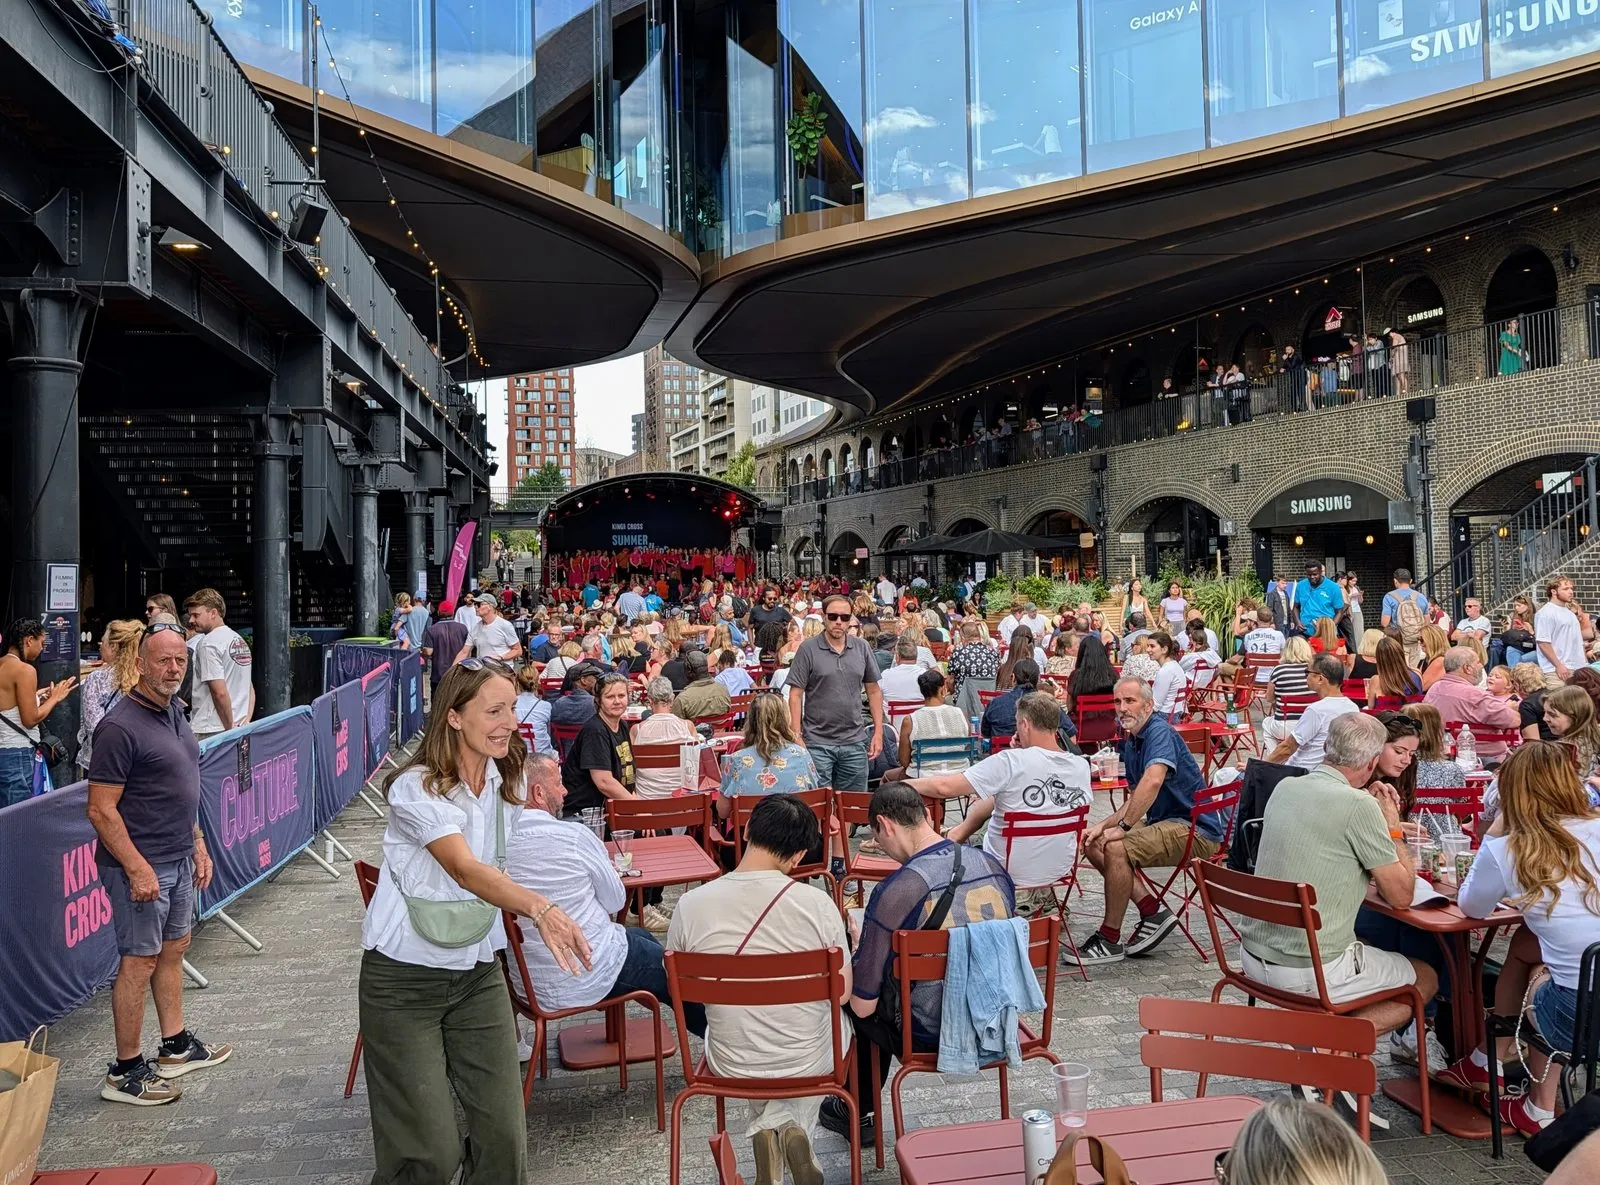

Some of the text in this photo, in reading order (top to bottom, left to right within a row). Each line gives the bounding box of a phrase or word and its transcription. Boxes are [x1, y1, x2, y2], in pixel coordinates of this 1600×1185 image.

[1130, 6, 1184, 30] Galaxy
[1407, 307, 1443, 323] SAMSUNG
[1290, 495, 1352, 515] SAMSUNG
[612, 534, 648, 546] SUMMER
[221, 749, 300, 849] CULTURE
